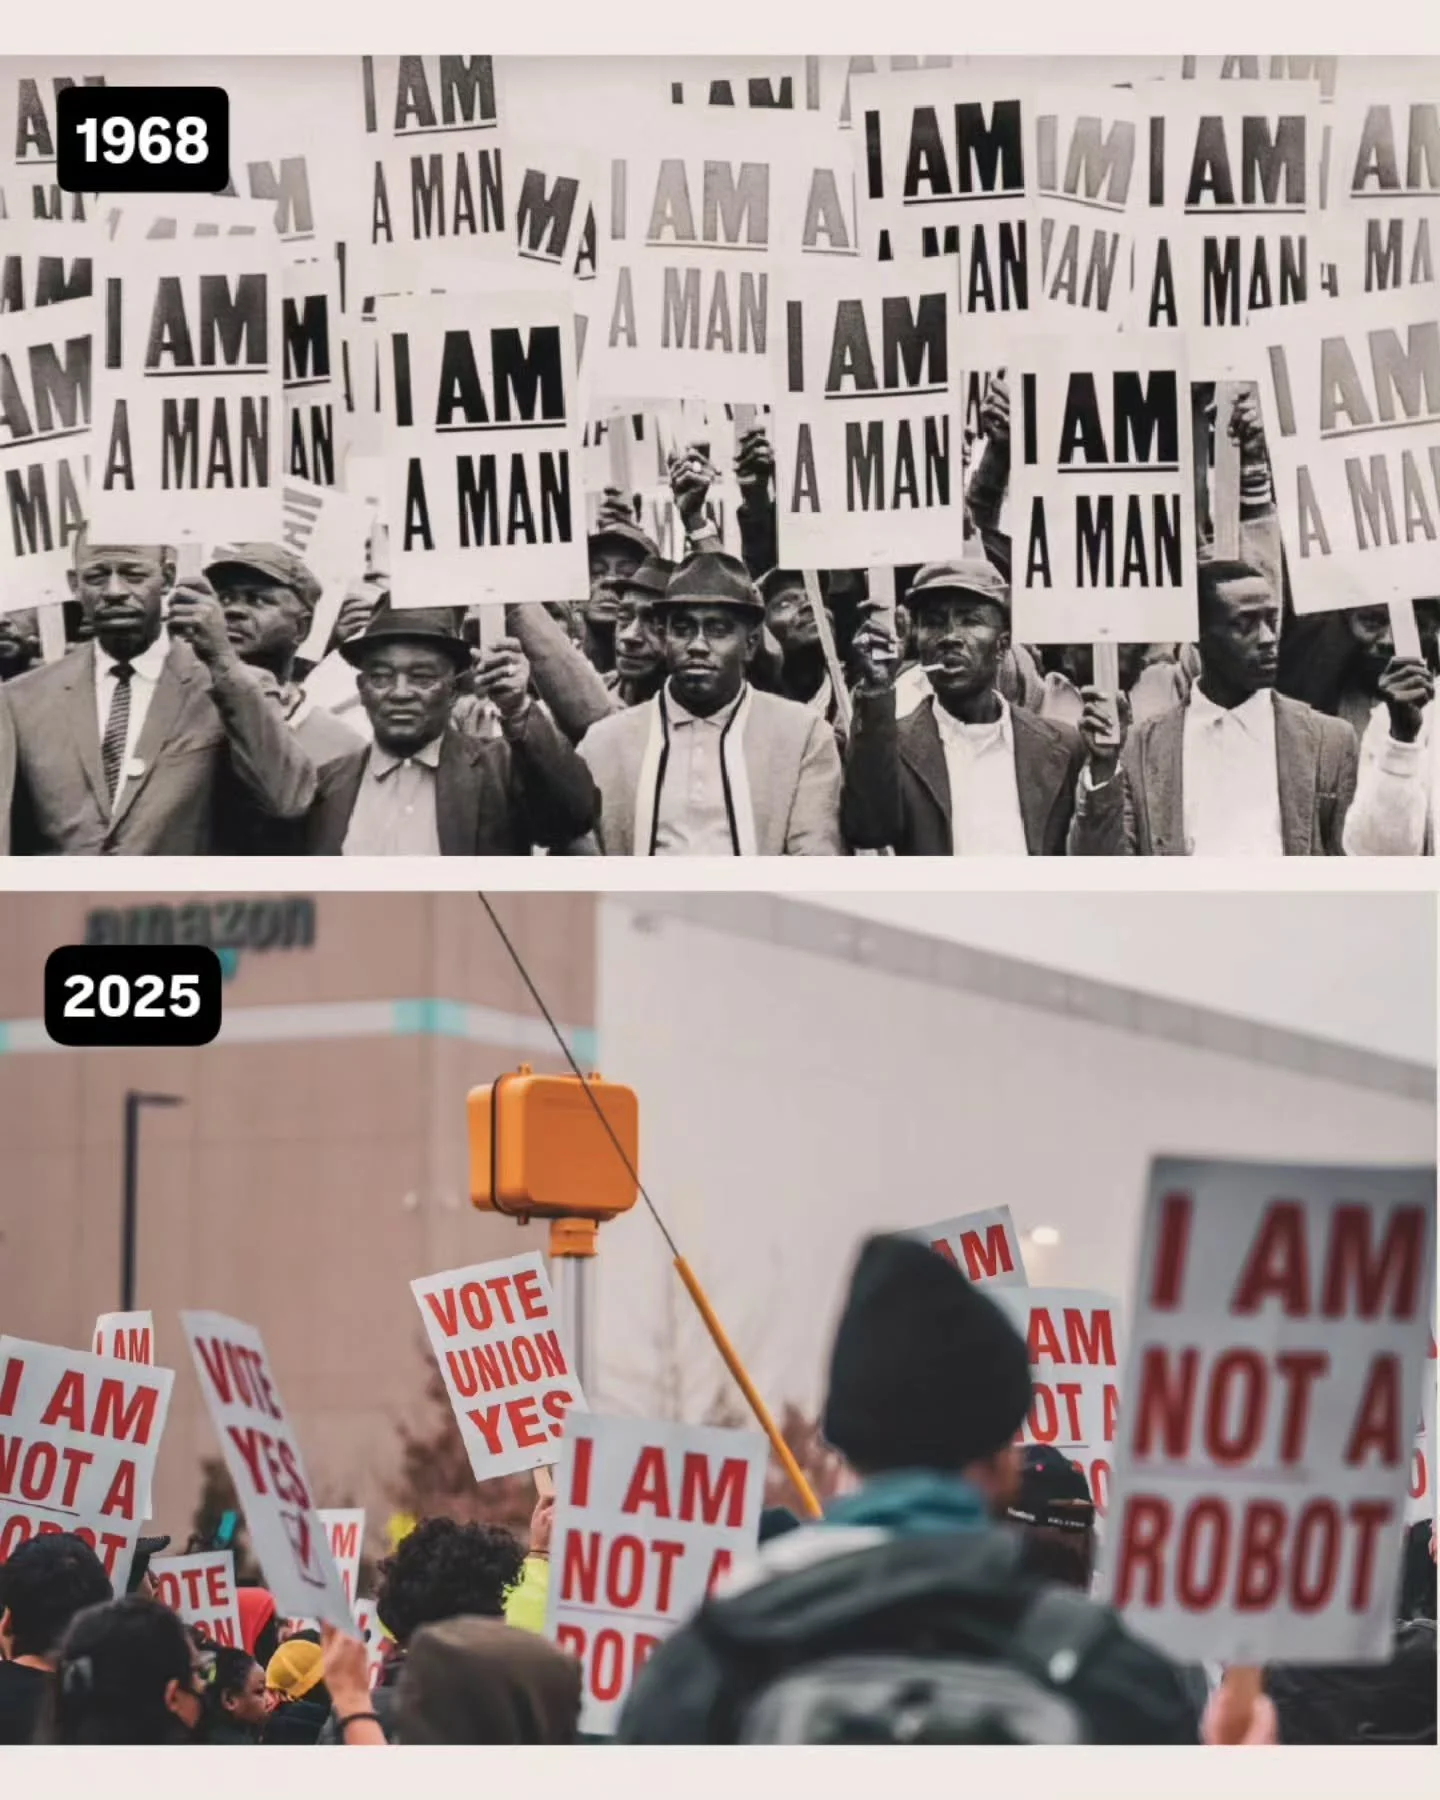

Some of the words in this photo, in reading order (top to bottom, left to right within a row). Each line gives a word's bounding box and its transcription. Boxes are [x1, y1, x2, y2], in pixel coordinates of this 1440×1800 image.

[363, 55, 377, 133] I
[394, 55, 497, 129] AM
[865, 110, 884, 199] I
[903, 99, 1025, 195] AM
[1149, 116, 1164, 206] I
[1184, 116, 1306, 205] AM
[372, 161, 393, 244] A
[411, 148, 505, 240] MAN
[611, 159, 626, 240] I
[646, 159, 770, 244] AM
[106, 278, 122, 369] I
[146, 274, 268, 368] AM
[609, 266, 637, 349] A
[661, 266, 768, 354] MAN
[1149, 238, 1178, 328] A
[1203, 235, 1307, 327] MAN
[392, 332, 414, 427] I
[436, 326, 566, 425] AM
[787, 300, 804, 392] I
[825, 293, 948, 392] AM
[1266, 345, 1297, 437] I
[1319, 321, 1438, 430] AM
[103, 399, 135, 490] A
[160, 396, 269, 490] MAN
[1021, 373, 1038, 465] I
[1058, 370, 1179, 464] AM
[5, 455, 91, 556] MA
[403, 457, 435, 552] A
[456, 449, 573, 548] MAN
[791, 423, 821, 513] A
[845, 414, 951, 513] MAN
[1025, 496, 1053, 588] A
[1076, 494, 1183, 588] MAN
[1296, 464, 1332, 559] A
[1150, 1189, 1192, 1311] I
[1229, 1197, 1426, 1321] AM
[113, 1327, 150, 1366] AM
[424, 1269, 549, 1338] VOTE
[1027, 1307, 1117, 1367] AM
[40, 1369, 159, 1446] AM
[194, 1335, 283, 1421] VOTE
[445, 1329, 568, 1398] UNION
[1131, 1343, 1330, 1467] NOT
[1343, 1353, 1400, 1467] A
[466, 1390, 575, 1456] YES
[1013, 1382, 1082, 1443] OT
[99, 1459, 136, 1521] A
[226, 1423, 311, 1511] YES
[570, 1437, 593, 1508] I
[621, 1445, 748, 1528] AM
[323, 1523, 357, 1559] M
[560, 1529, 685, 1614] NOT
[1111, 1494, 1391, 1614] ROBOT
[154, 1565, 229, 1612] OTE
